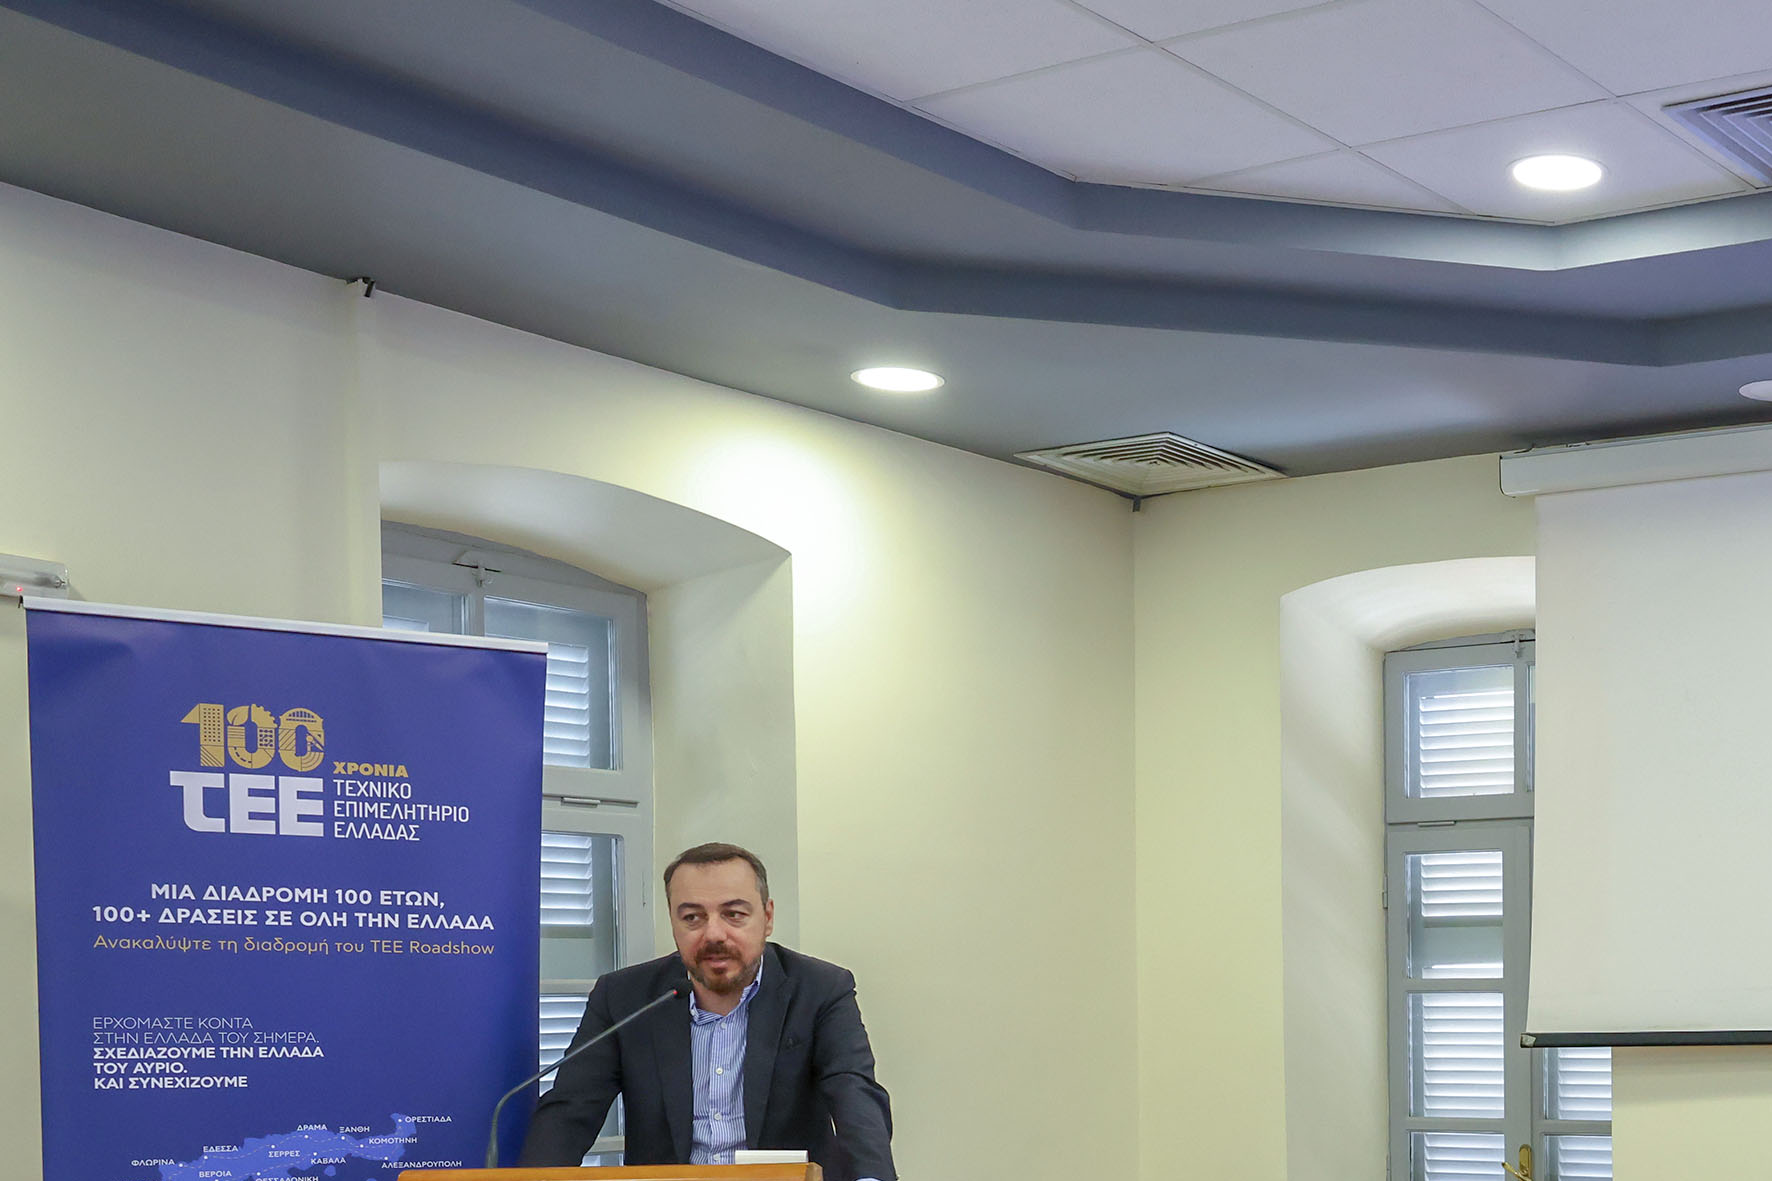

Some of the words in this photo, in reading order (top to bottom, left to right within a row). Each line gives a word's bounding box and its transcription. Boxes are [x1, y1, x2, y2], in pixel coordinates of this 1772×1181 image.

[180, 703, 325, 772] 100
[333, 762, 408, 778] ΧΡΟΝΙΑ
[333, 779, 411, 799] ΤΕΧΝΙΚΟ
[334, 801, 469, 823] ΕΠΙΜΕΛΗΤΗΡΙΟ
[334, 822, 420, 841] ΕΛΛΑΔΑΣ
[151, 883, 195, 900] ΜΙΑ
[203, 885, 327, 903] ΔΙΑΔΡΟΜΗ
[336, 889, 371, 904] 100
[380, 891, 445, 909] ΕΤΩΝ,
[93, 906, 150, 922] 100+
[159, 908, 257, 925] ΔΡΑΣΕΙΣ
[265, 910, 292, 925] ΣΕ
[300, 911, 347, 927] ΟΛΗ
[354, 912, 399, 928] ΤΗΝ
[407, 914, 494, 930] ΕΛΛΑΔΑ
[93, 935, 212, 952] Ανακαλύψτε
[218, 940, 237, 954] τη
[244, 937, 328, 955] διαδρομή
[335, 941, 364, 953] του
[370, 940, 403, 953] ΤΕΕ
[410, 940, 494, 955] Roadshow
[93, 1017, 193, 1030] ΕΡΧΟΜΑΣΤΕ
[199, 1017, 253, 1029] ΚΟΝΤΑ
[93, 1032, 138, 1045] ΣΤΗΝ
[144, 1032, 213, 1044] ΕΛΛΑΔΑ
[219, 1032, 249, 1044] ΤΟΥ
[253, 1031, 319, 1044] ΣΗΜΕΡΑ.
[93, 1047, 215, 1059] ΣΧΕΔΙΑΖΟΥΜΕ
[220, 1047, 253, 1058] ΤΗΝ
[259, 1046, 324, 1058] ΕΛΛΑΔΑ
[94, 1062, 128, 1074] ΤΟΥ
[133, 1062, 187, 1074] ΑΥΡΙΟ.
[94, 1077, 123, 1089] ΚΑΙ
[129, 1076, 248, 1089] ΣΥΝΕΧΙΖΟΥΜΕ
[369, 1137, 417, 1145] ΚΟΜΟΤΗΝΗ
[268, 1150, 300, 1158] ΣΕΡΡΕΣ
[311, 1157, 346, 1165] ΚΑΒΑΛΑ
[382, 1160, 462, 1169] ΑΛΕΞΑΝΔΡΟΥΠΟΛΗ
